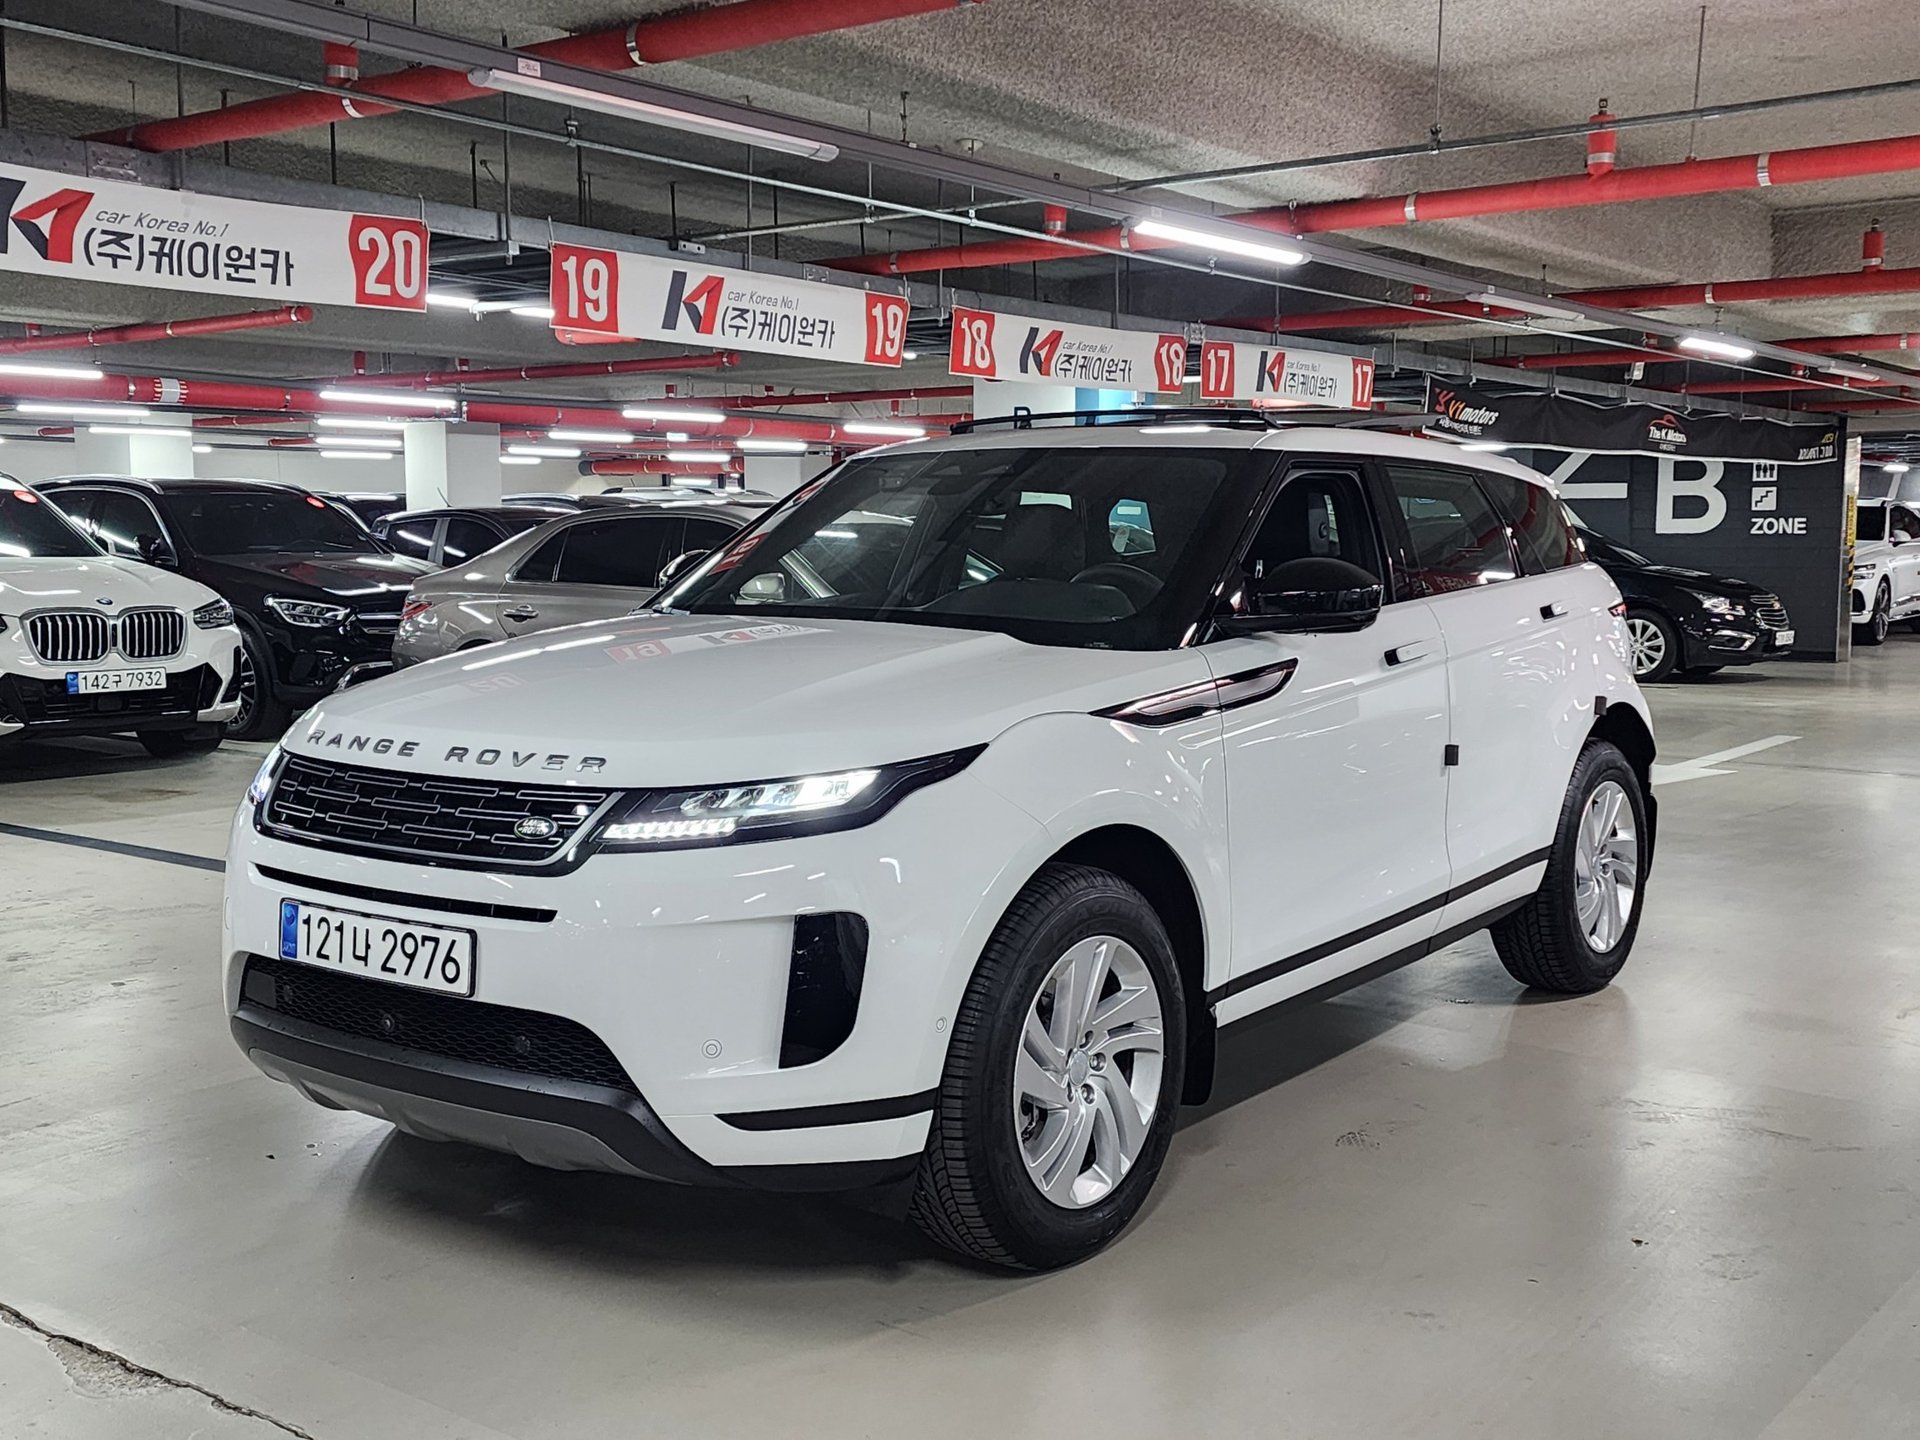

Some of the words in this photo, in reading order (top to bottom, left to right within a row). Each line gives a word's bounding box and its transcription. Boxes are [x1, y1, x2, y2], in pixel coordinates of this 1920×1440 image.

[95, 210, 130, 225] car
[134, 212, 190, 234] Korea
[192, 220, 230, 238] No.1
[83, 227, 295, 287] (주)케이원카
[357, 226, 422, 299] 20
[561, 254, 609, 323] 19
[727, 289, 747, 303] car
[749, 290, 779, 308] Korea
[780, 295, 800, 311] No.1
[721, 305, 836, 350] (주)케이원카
[870, 301, 905, 359] 19
[959, 316, 991, 369] 18
[1062, 340, 1076, 350] car
[1076, 341, 1098, 353] Korea
[1054, 352, 1132, 383] (주)케이원카
[1158, 341, 1184, 387] 18
[1206, 346, 1231, 393] 17
[1283, 371, 1338, 399] (주)케이원카
[1355, 363, 1373, 403] 17
[1655, 456, 1727, 535] B
[1750, 517, 1807, 535] ZONE
[81, 674, 123, 691] 142구
[126, 670, 163, 687] 7932
[306, 730, 420, 758] RANGE
[444, 746, 608, 774] ROVER
[302, 913, 372, 967] 121나
[380, 928, 461, 984] 2976
